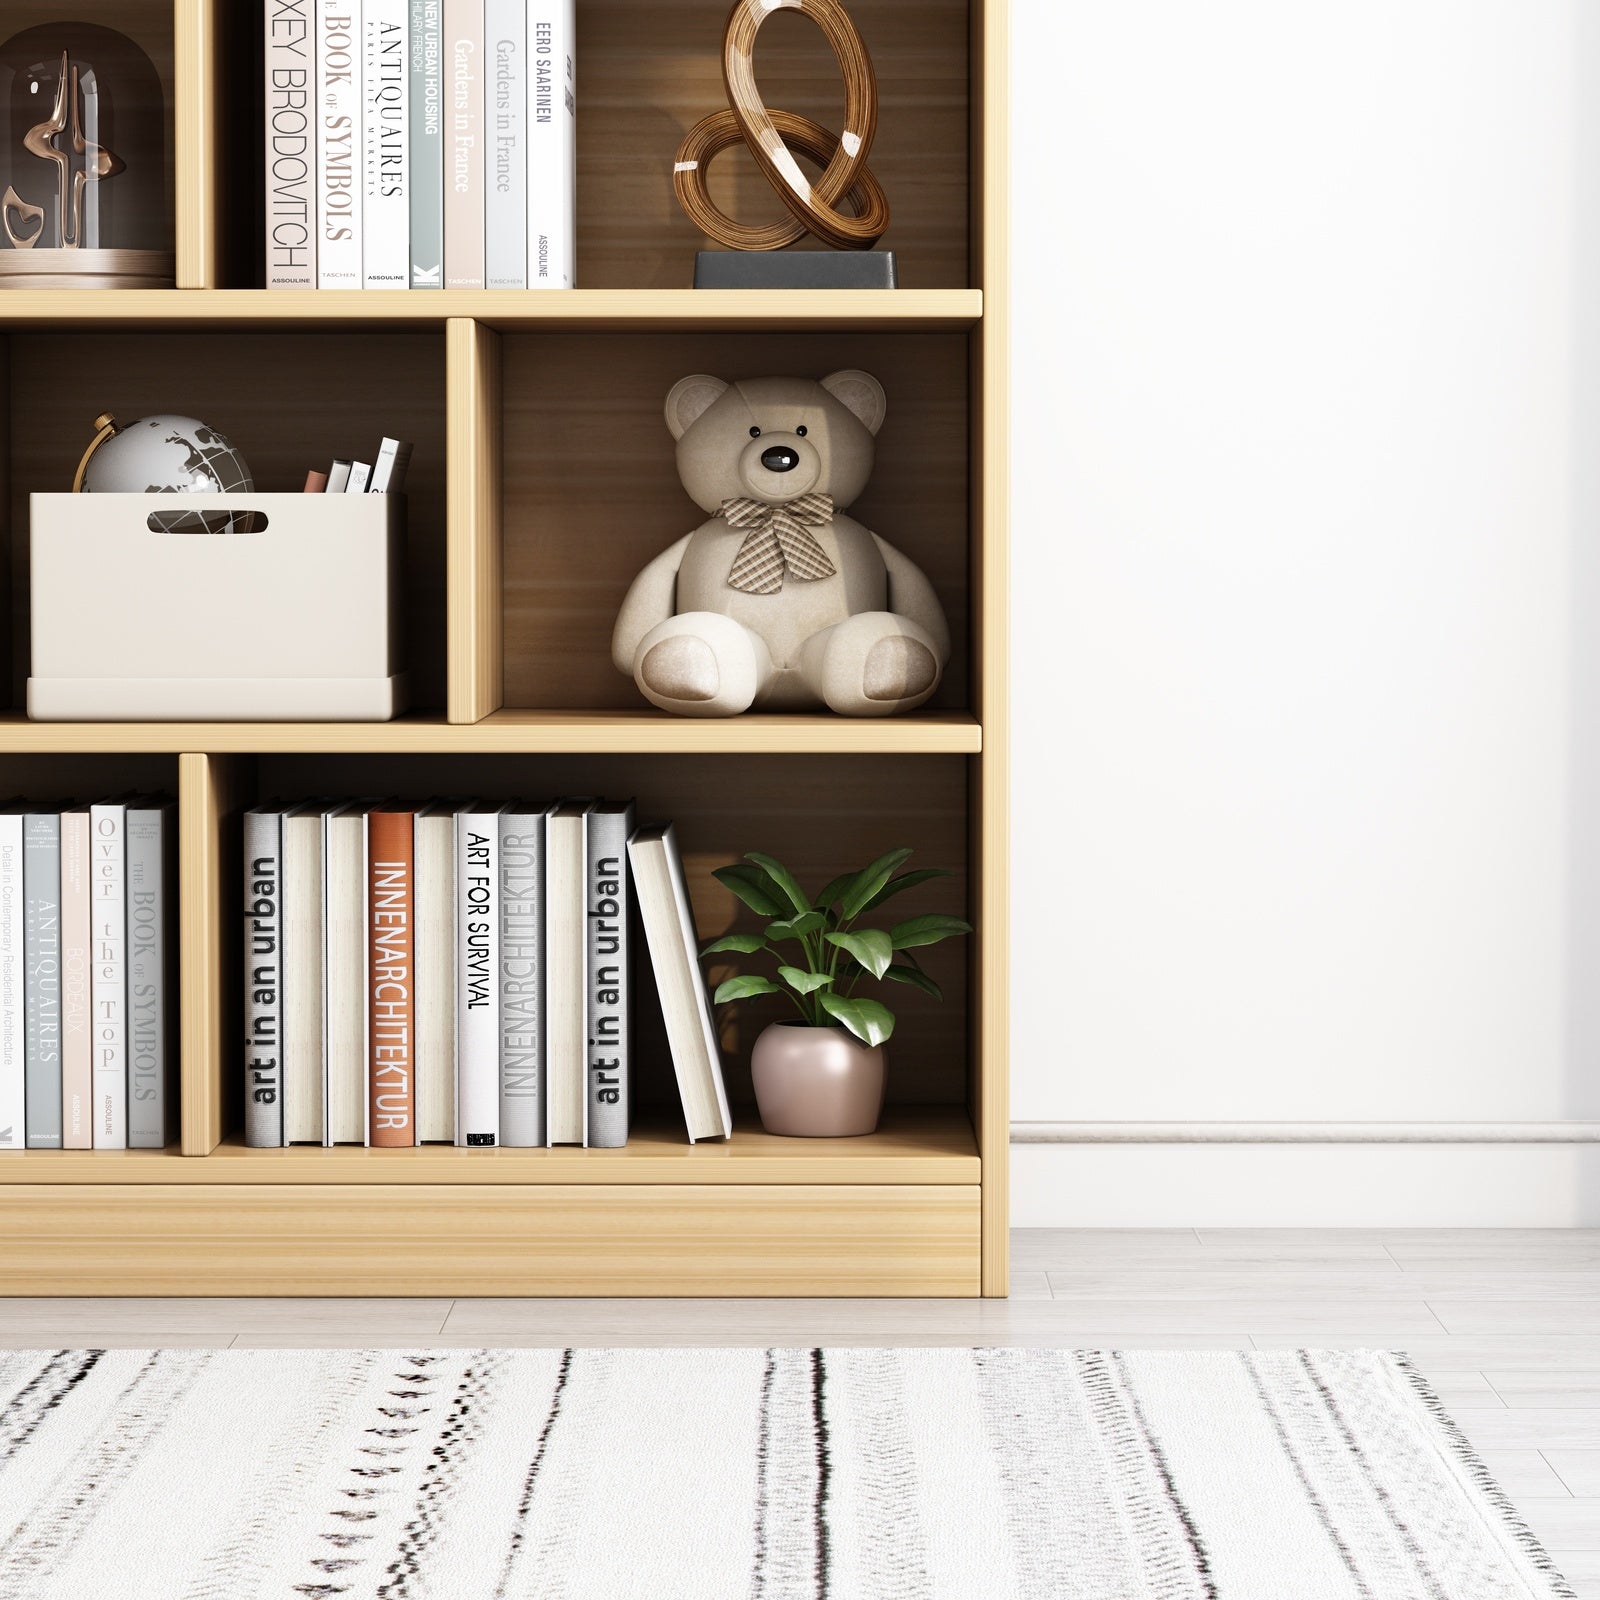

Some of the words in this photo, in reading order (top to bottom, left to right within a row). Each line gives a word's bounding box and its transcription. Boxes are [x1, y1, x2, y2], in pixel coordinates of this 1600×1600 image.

[412, 1, 423, 34] HILARY
[424, 1, 438, 30] NEW
[537, 23, 551, 53] EERO
[325, 16, 352, 87] BOOK
[412, 35, 423, 72] FRENCH
[424, 32, 438, 75] URBAN
[455, 40, 474, 109] Gardens
[497, 40, 515, 109] Gardens
[375, 22, 402, 196] ANTIQUAIRES
[424, 78, 438, 135] HOUSING
[537, 60, 551, 122] SAARINEN
[455, 113, 474, 129] in
[497, 114, 515, 129] in
[272, 69, 308, 266] BRODOVITCH
[325, 116, 352, 240] SYMBOLS
[455, 135, 474, 193] France
[497, 135, 515, 192] France
[539, 235, 547, 277] ASSOULINE
[2, 845, 14, 872] Detail
[468, 833, 489, 868] ART
[3, 875, 13, 883] in
[244, 856, 276, 955] urban
[468, 877, 490, 915] FOR
[588, 856, 620, 955] urban
[0, 886, 14, 952] Contemporary
[134, 891, 156, 957] BOOK
[3, 955, 15, 1007] Residential
[35, 900, 57, 1061] ANTIQUAIRES
[66, 947, 85, 1034] BORDEAUX
[253, 966, 276, 1005] an
[467, 923, 489, 1009] SURVIVAL
[502, 833, 537, 1098] INNENARCHITEKTUR
[595, 966, 620, 1005] an
[374, 862, 409, 1130] INNENARCHITEKTUR
[3, 1009, 15, 1065] Architecture
[134, 984, 157, 1102] SYMBOLS
[245, 1015, 276, 1046] in
[589, 1015, 620, 1046] in
[249, 1056, 276, 1105] art
[592, 1056, 620, 1105] art
[105, 1094, 113, 1136] ASSOULINE
